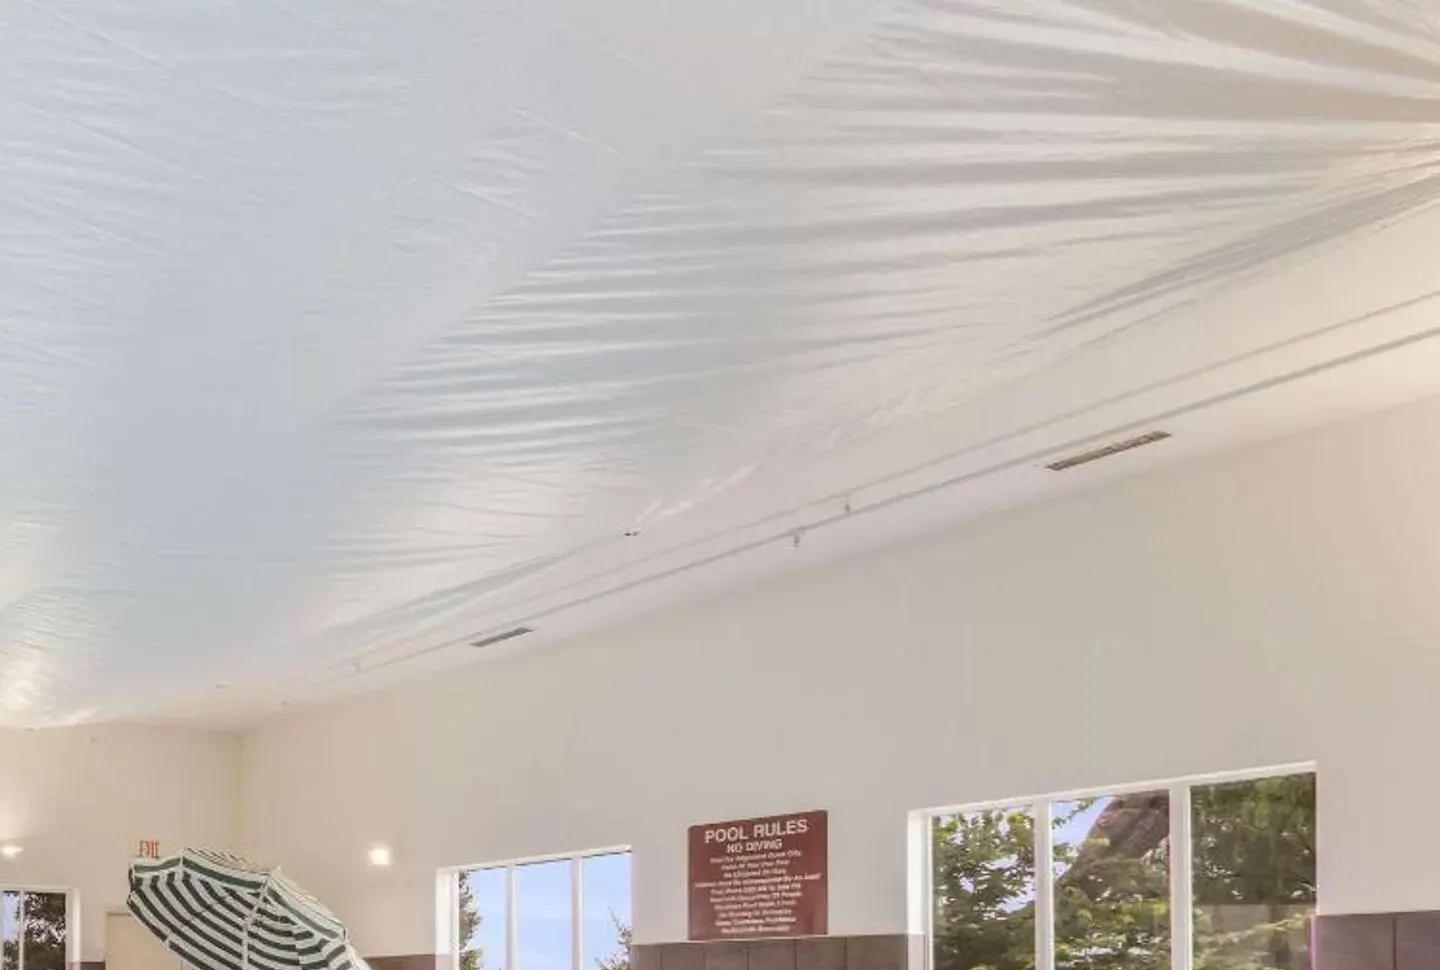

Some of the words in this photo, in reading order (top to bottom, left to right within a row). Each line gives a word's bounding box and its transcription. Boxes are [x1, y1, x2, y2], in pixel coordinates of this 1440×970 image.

[705, 827, 748, 843] POOL
[753, 819, 808, 839] RULES
[726, 842, 744, 854] NO
[746, 838, 783, 852] DIVING
